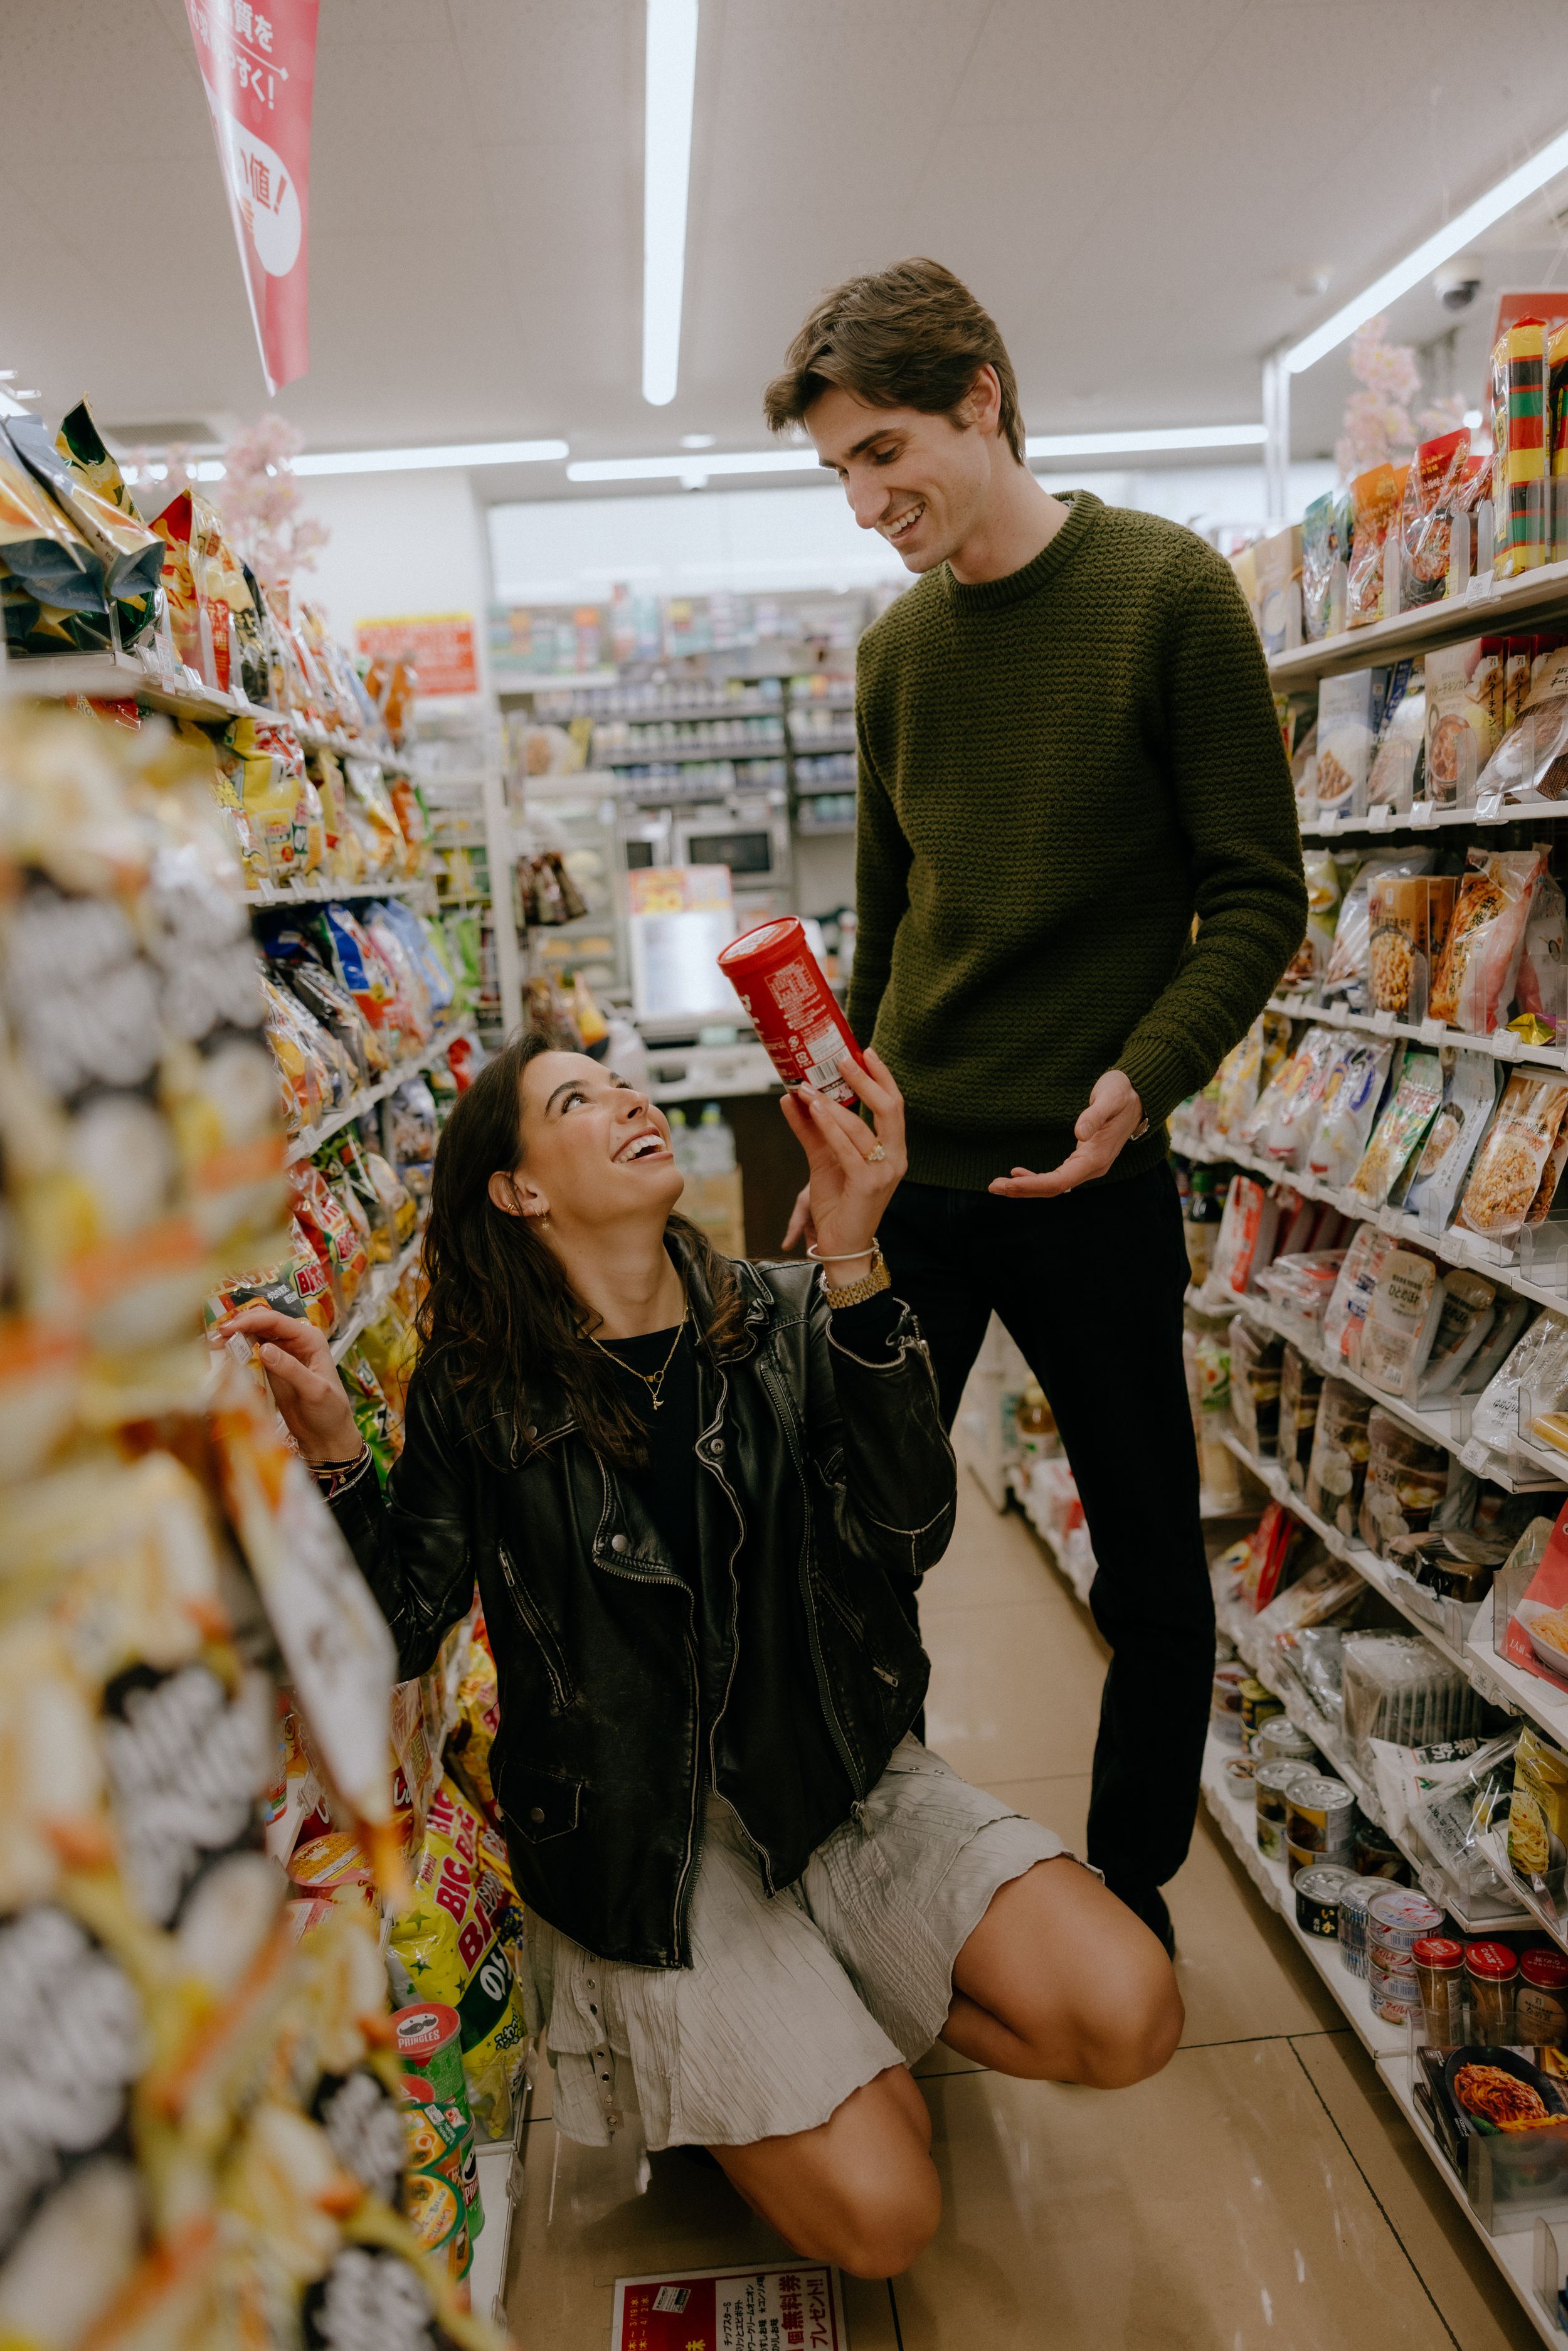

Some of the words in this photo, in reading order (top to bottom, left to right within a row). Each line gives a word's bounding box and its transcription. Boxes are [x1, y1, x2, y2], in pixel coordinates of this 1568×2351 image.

[1508, 1638, 1526, 1656] 1人前
[435, 1854, 471, 1926] BIG
[1321, 1908, 1336, 1934] いか
[398, 2029, 440, 2049] PRINGLES
[723, 2301, 733, 2347] チップスターS
[807, 2278, 829, 2348] プレゼント!!
